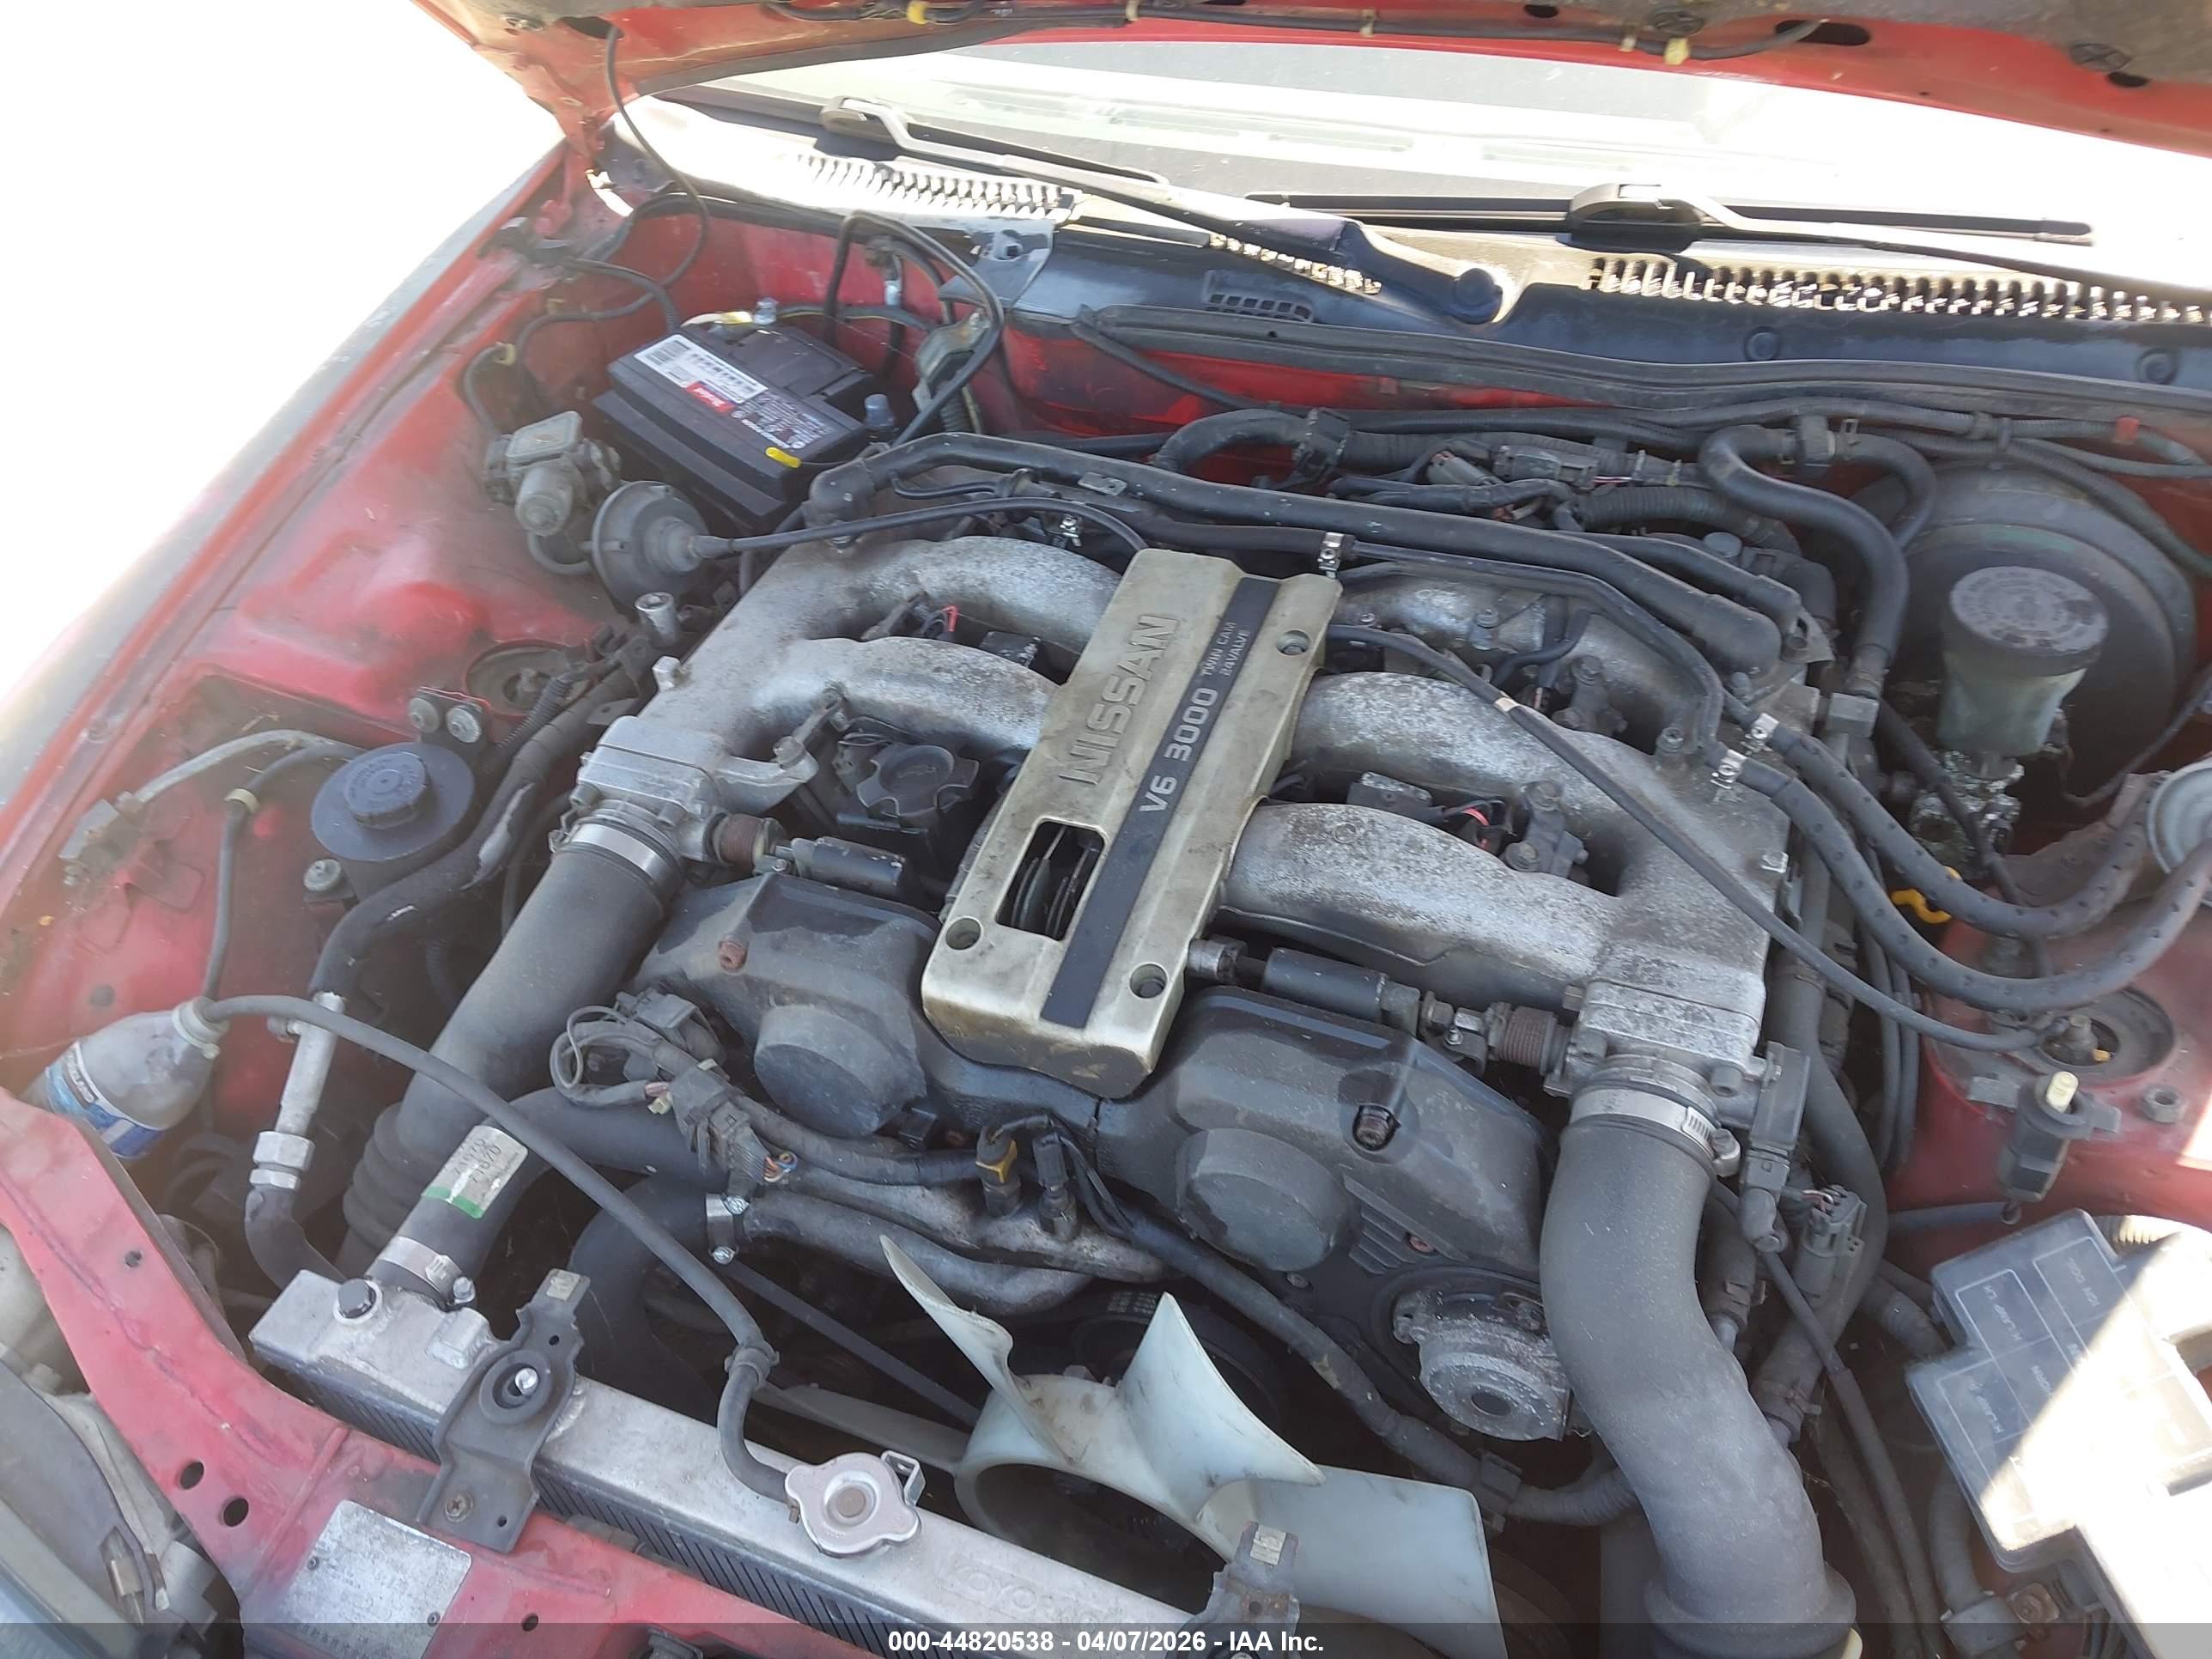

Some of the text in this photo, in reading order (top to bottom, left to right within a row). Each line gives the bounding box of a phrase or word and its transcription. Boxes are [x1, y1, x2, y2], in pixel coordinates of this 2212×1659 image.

[1058, 614, 1181, 785] NISSAN
[1200, 622, 1237, 677] TWIN CAM
[1138, 687, 1219, 812] V6 3000
